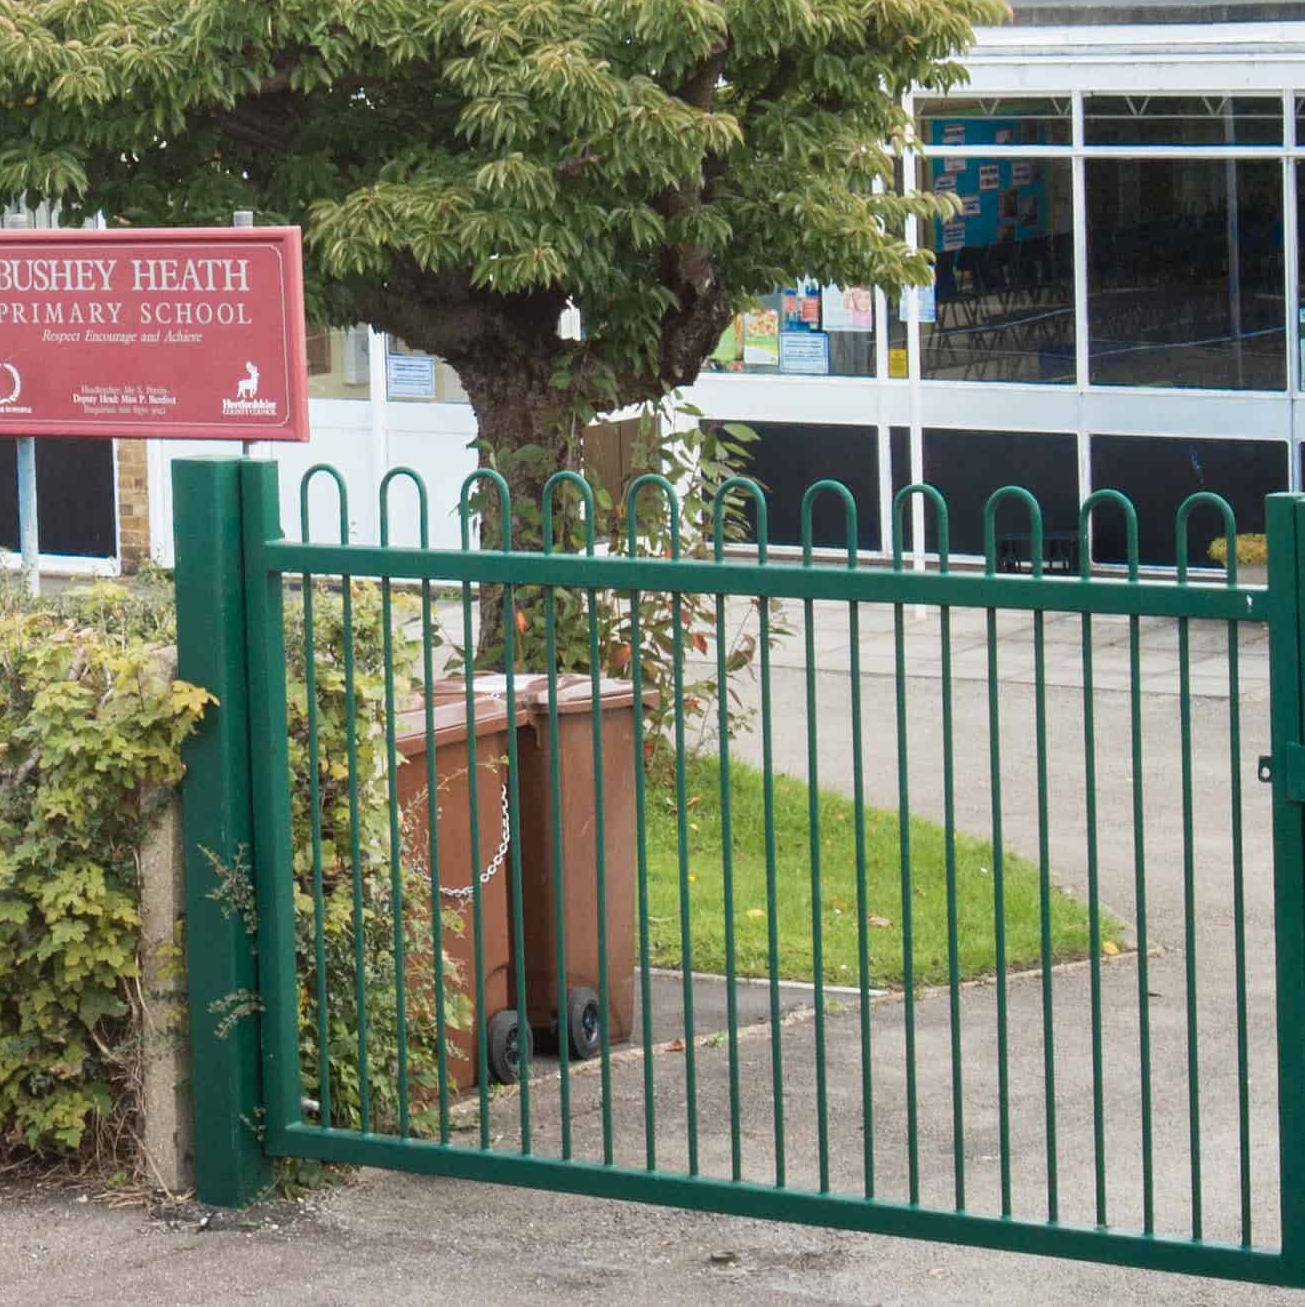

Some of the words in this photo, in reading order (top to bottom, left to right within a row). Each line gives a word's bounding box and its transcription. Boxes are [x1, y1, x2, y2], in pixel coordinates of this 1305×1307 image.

[132, 259, 251, 291] HEATH
[140, 302, 252, 325] SCHOOL
[42, 329, 80, 343] Respect
[85, 329, 137, 345] Encourage
[141, 330, 160, 342] and
[164, 330, 203, 342] Achieve
